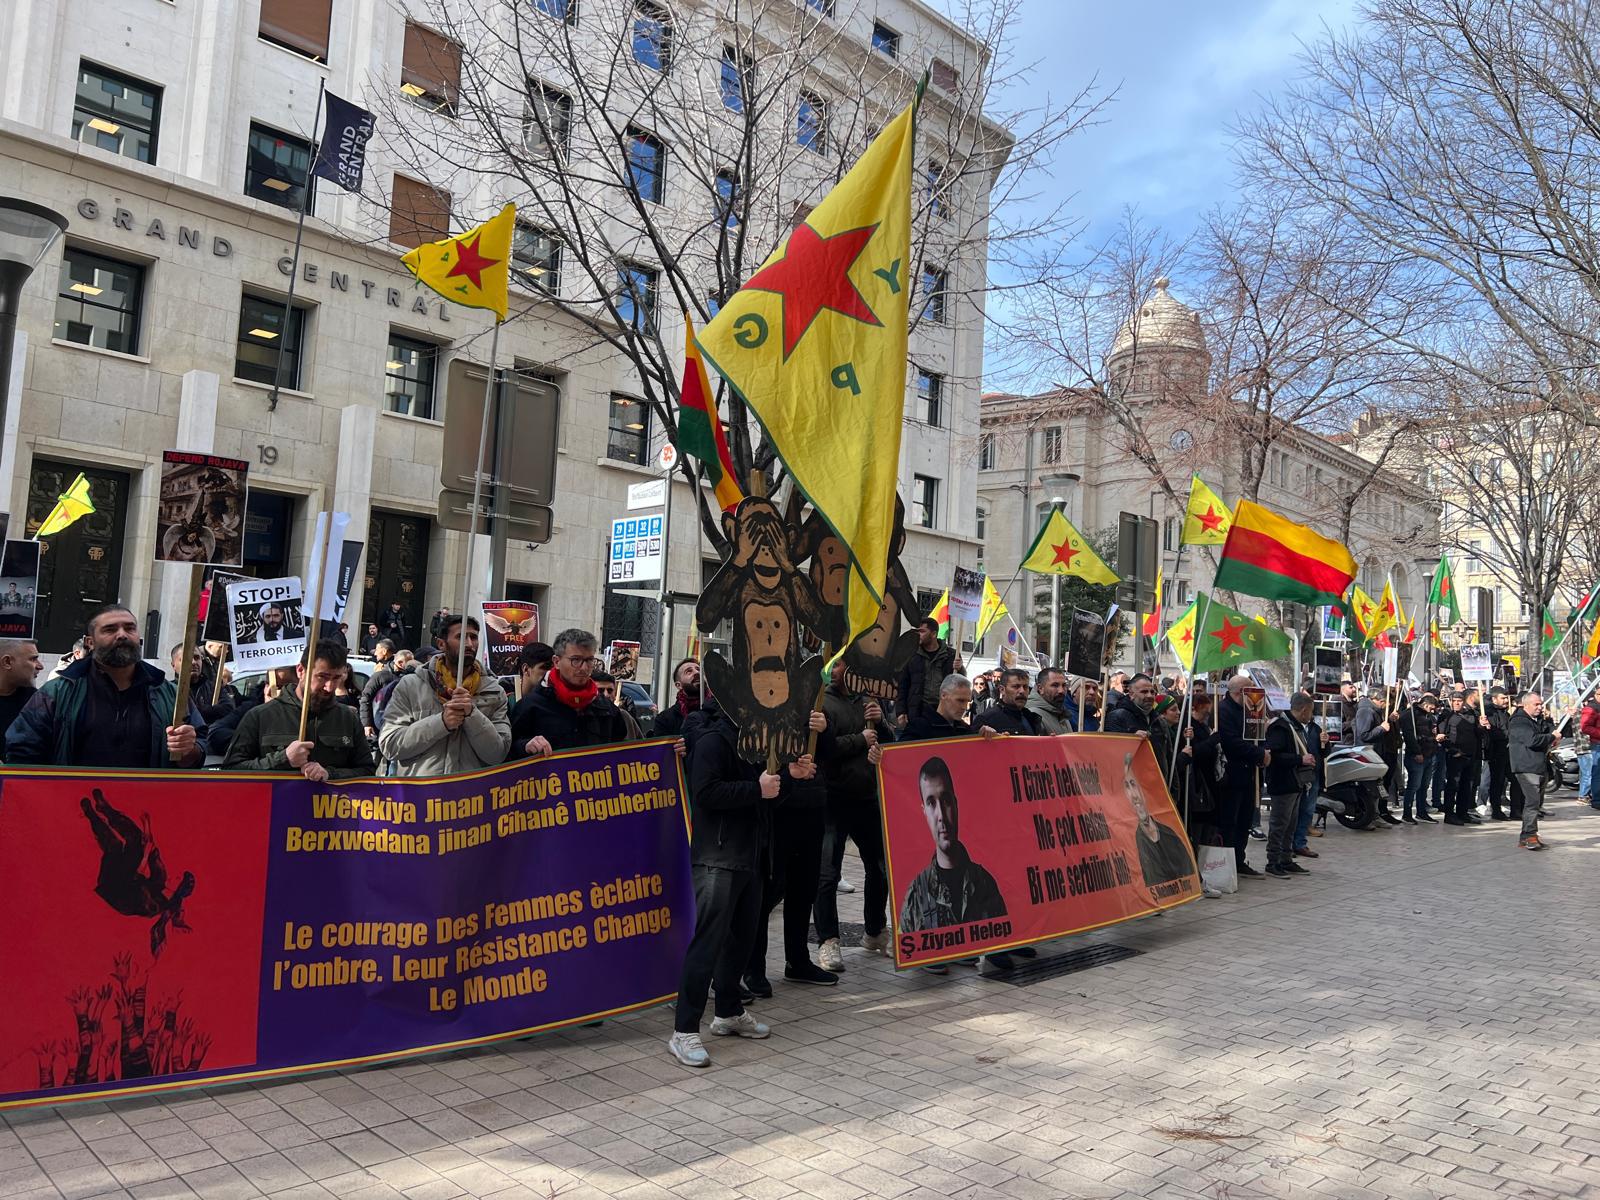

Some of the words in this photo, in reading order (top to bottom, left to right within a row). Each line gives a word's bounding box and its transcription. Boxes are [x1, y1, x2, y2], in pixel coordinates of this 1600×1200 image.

[77, 198, 233, 257] GRAND
[277, 256, 451, 322] CENTRAL
[165, 451, 205, 465] DEFEND
[207, 457, 246, 471] ROJAVA
[257, 443, 279, 466] 19
[238, 585, 291, 604] STOP!
[239, 643, 305, 659] TERRORISTE
[491, 644, 524, 653] KURDIS
[504, 634, 525, 642] FREE
[312, 793, 417, 825] Wêrekiya
[424, 793, 484, 823] Jinan
[568, 765, 612, 793] Ronî
[617, 761, 661, 785] Dike
[286, 826, 430, 854] Berxwedana
[574, 787, 676, 823] Diguherîne
[1033, 813, 1056, 851] Me
[1056, 810, 1079, 856] çok
[1026, 865, 1044, 905] Bi
[1044, 870, 1066, 902] me
[284, 920, 313, 951] Le
[321, 921, 428, 950] courage
[436, 913, 479, 945] Des
[485, 889, 583, 931] Femmes
[969, 920, 1013, 942] Helep
[392, 955, 449, 982] Leur
[455, 933, 587, 974] Résistance
[593, 904, 671, 944] Change
[429, 986, 457, 1012] Le
[463, 965, 548, 1006] Monde
